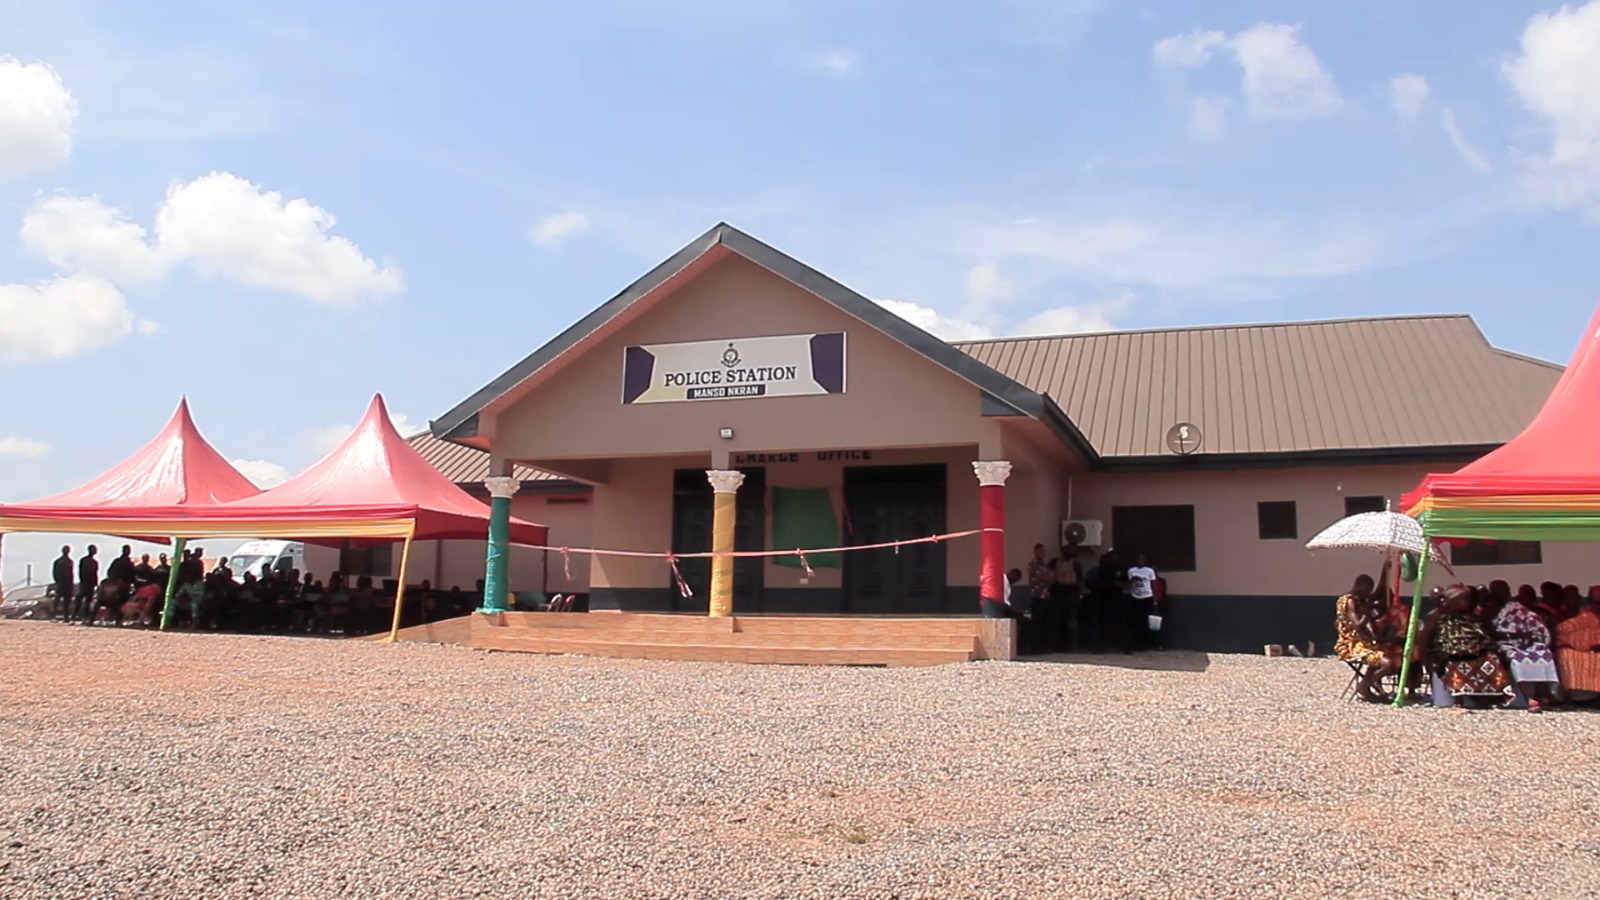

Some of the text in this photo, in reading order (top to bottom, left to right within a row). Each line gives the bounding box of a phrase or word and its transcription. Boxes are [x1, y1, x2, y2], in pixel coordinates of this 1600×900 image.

[664, 366, 797, 387] POLICE STATION
[693, 385, 759, 398] MANSO NKRAN
